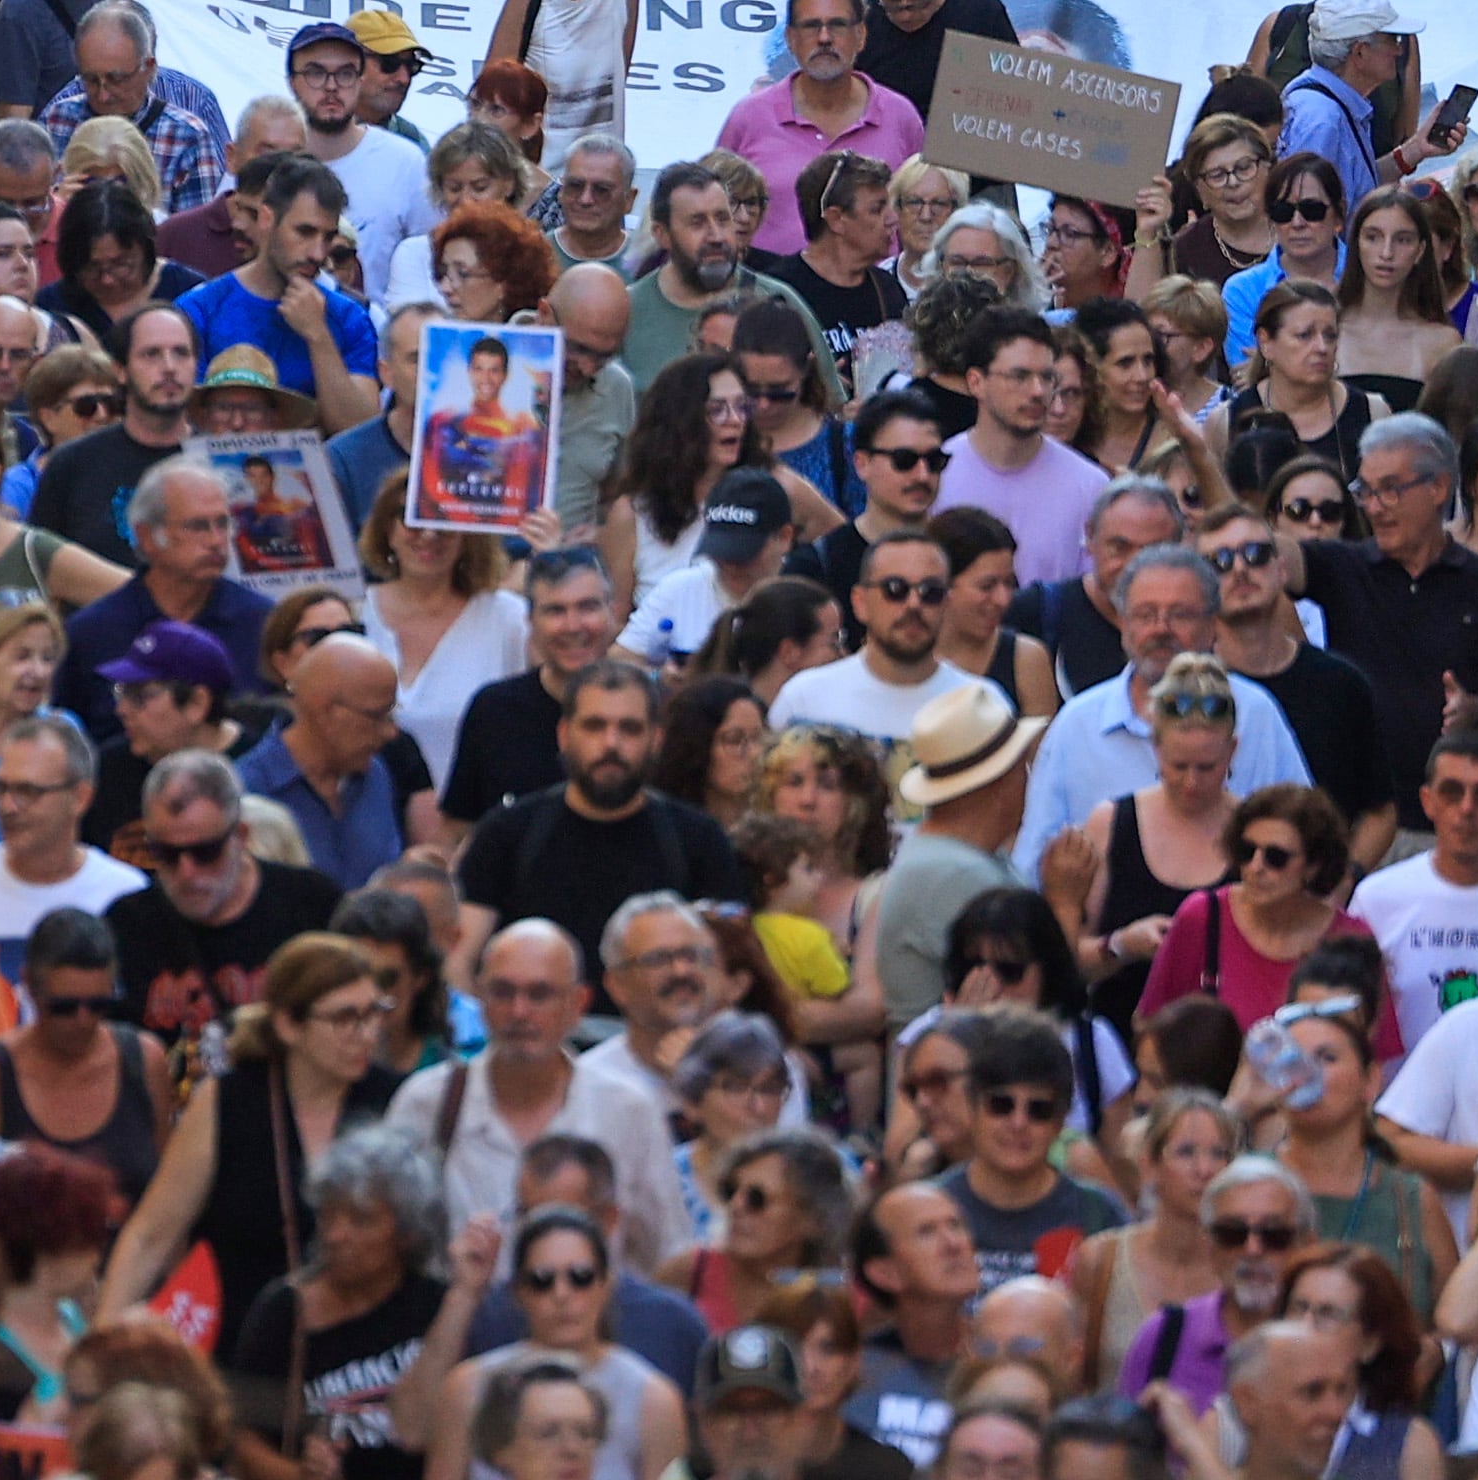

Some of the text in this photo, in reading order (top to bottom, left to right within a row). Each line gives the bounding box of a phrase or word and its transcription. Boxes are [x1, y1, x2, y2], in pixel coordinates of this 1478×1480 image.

[989, 51, 1162, 114] VOLEM ASCENSORS
[952, 112, 1083, 160] VOLEM CASES
